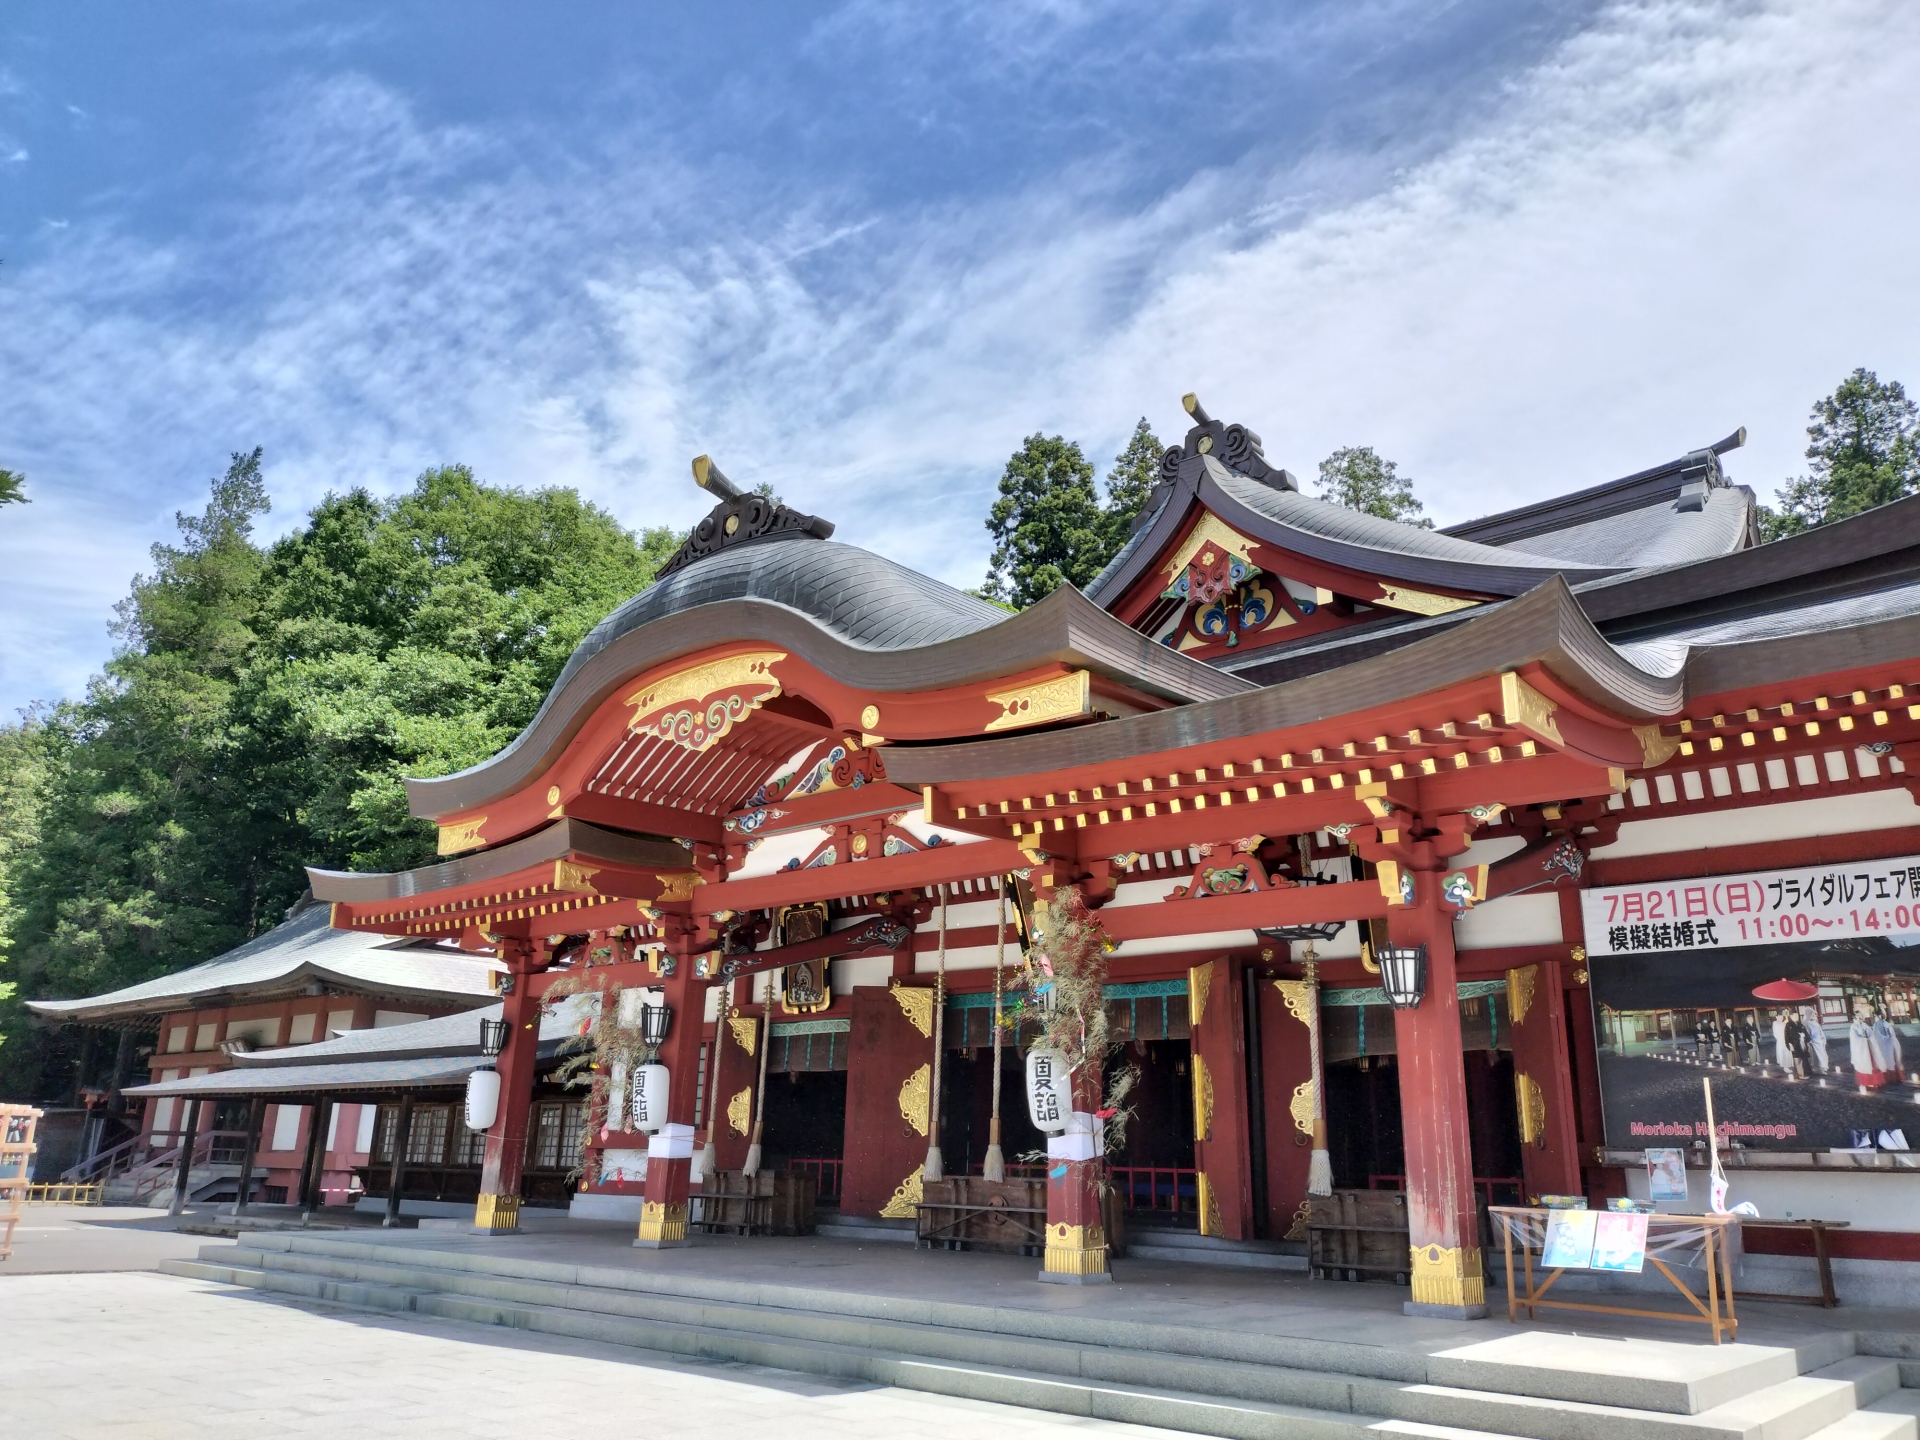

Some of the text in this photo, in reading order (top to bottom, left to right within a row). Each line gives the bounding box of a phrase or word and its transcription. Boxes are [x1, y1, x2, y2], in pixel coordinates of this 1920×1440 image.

[1608, 919, 1719, 952] 模擬結婚式
[1631, 1121, 1693, 1136] Morioka
